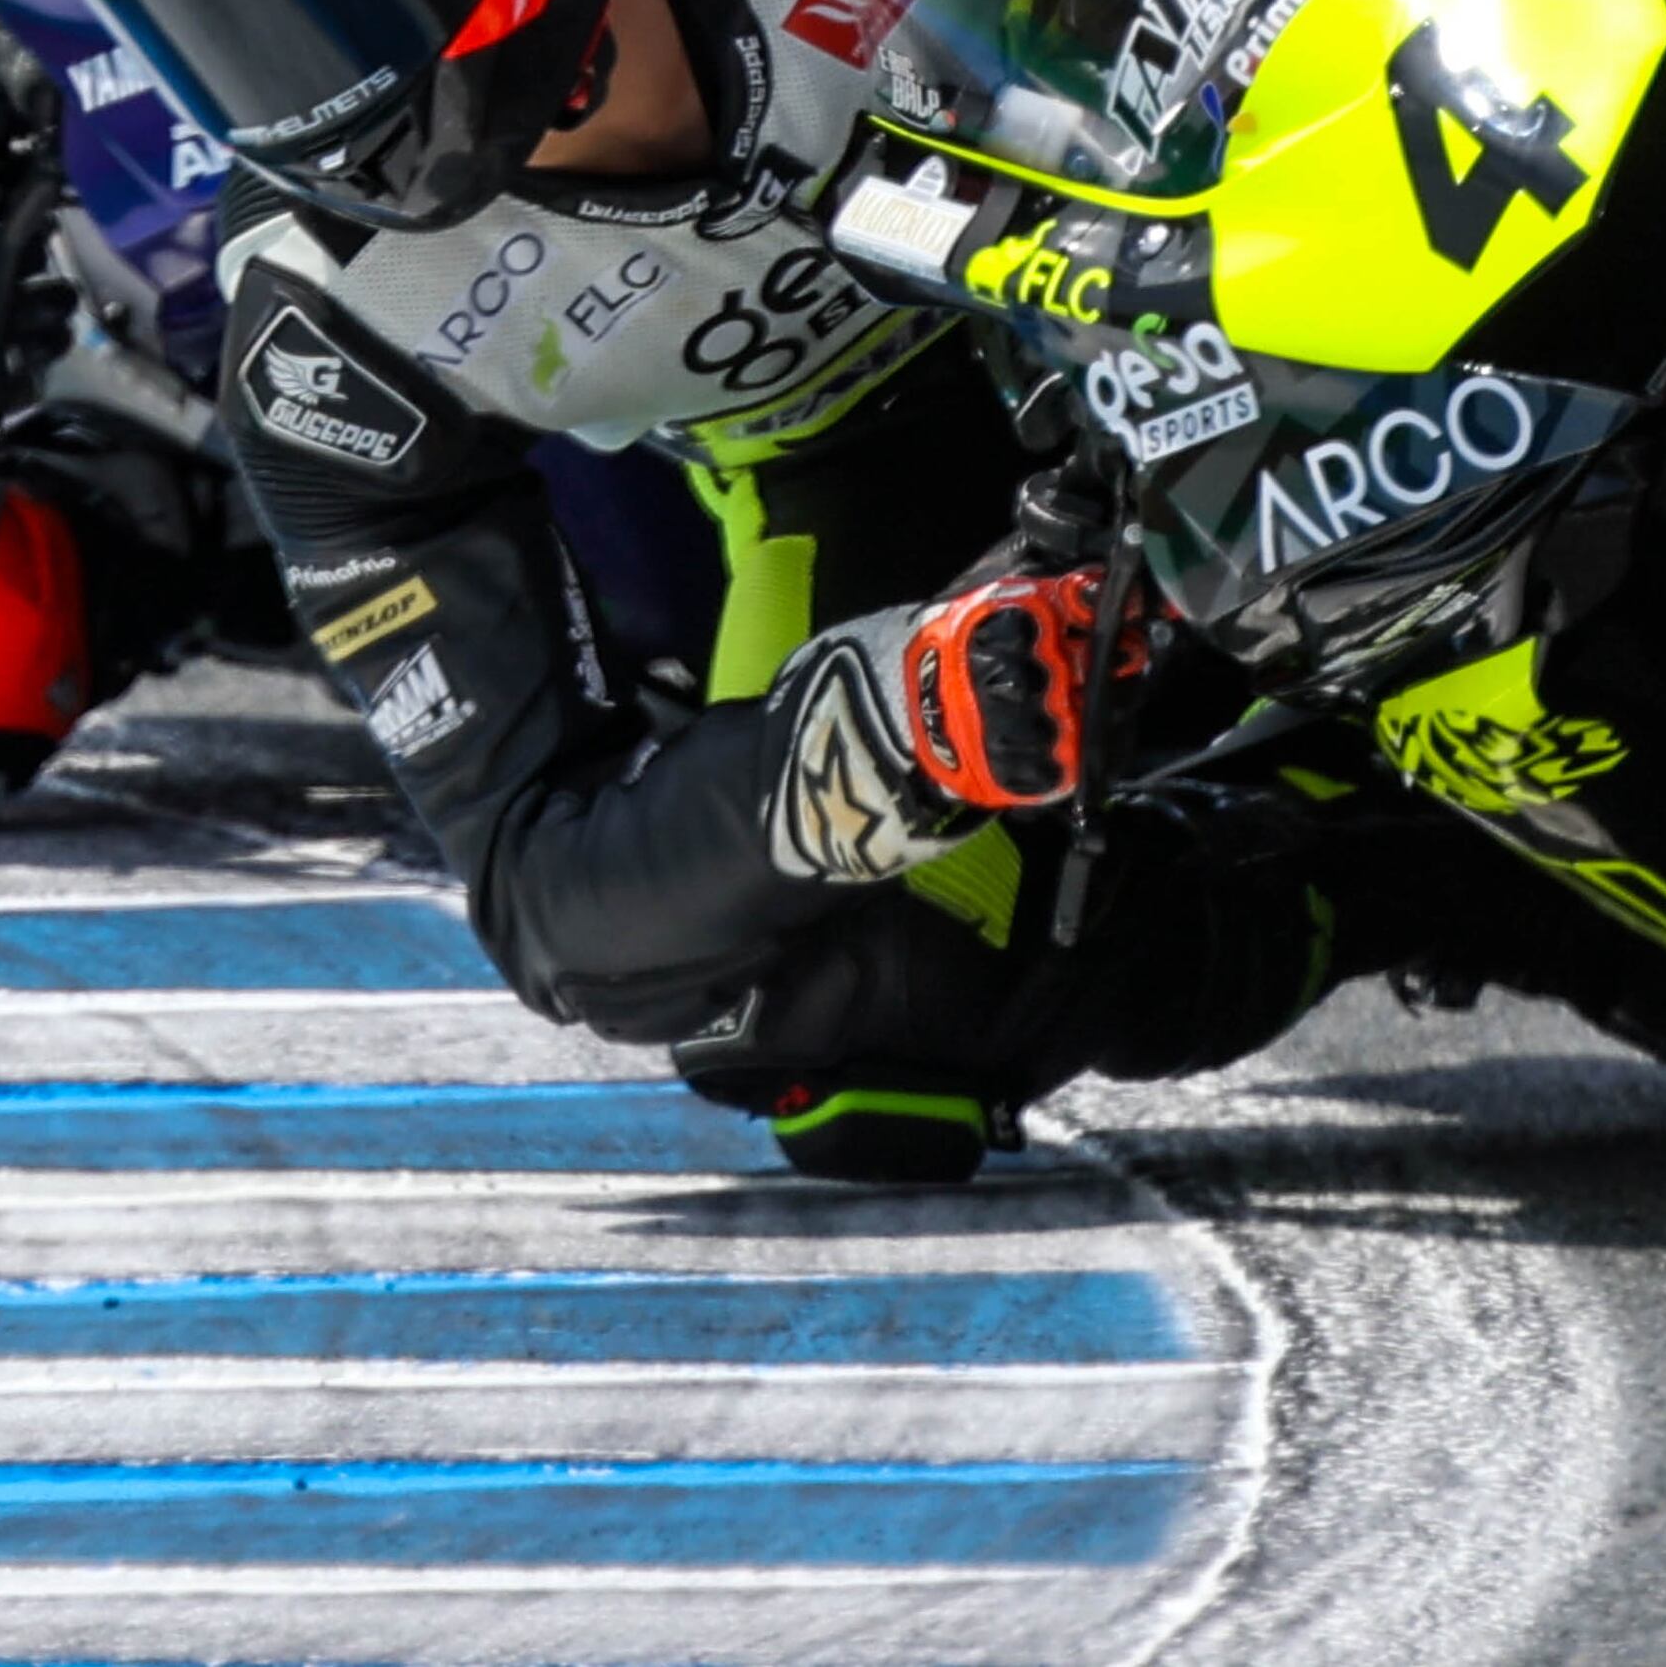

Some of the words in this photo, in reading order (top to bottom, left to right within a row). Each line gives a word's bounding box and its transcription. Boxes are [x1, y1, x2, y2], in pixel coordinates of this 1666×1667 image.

[1386, 16, 1589, 274] 4
[565, 250, 661, 337] FLC
[1019, 248, 1112, 325] FLC
[1145, 392, 1254, 456] SPORTS
[1261, 376, 1531, 574] ARCO
